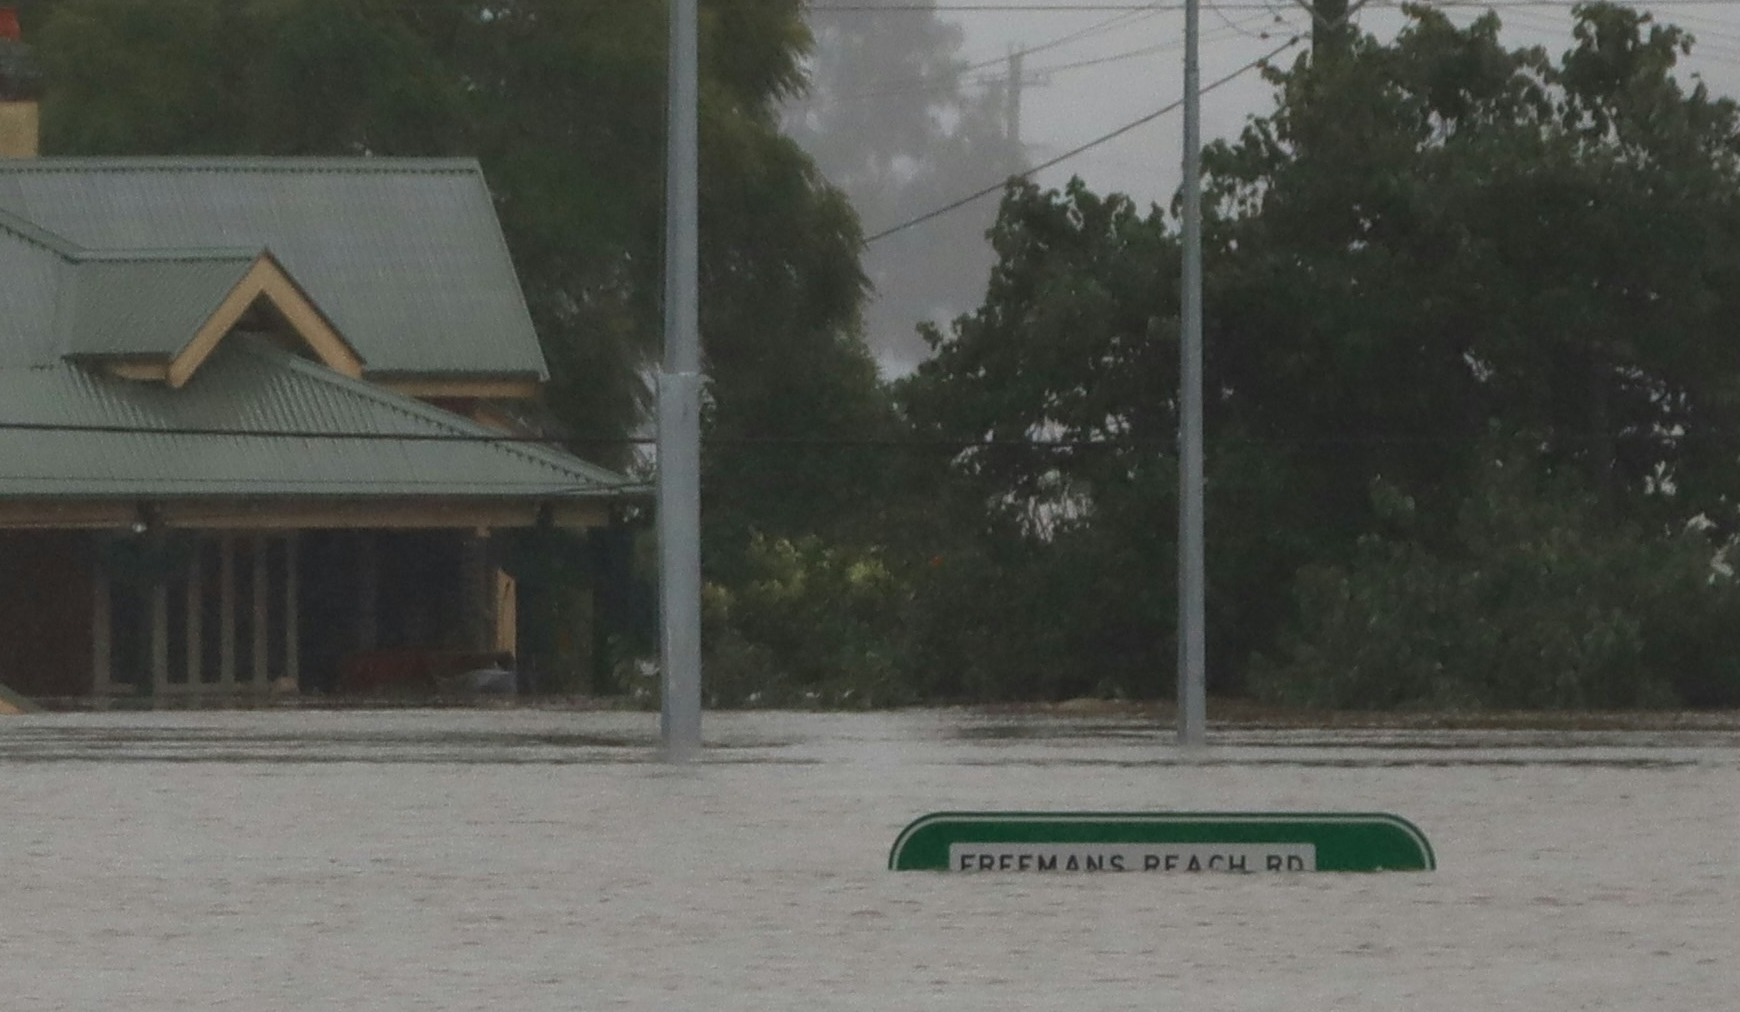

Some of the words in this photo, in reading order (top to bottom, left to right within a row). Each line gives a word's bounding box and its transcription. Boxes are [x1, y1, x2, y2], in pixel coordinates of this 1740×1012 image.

[960, 853, 1125, 872] FREEMANS
[1144, 853, 1246, 872] BEACH
[1266, 853, 1304, 872] RD
